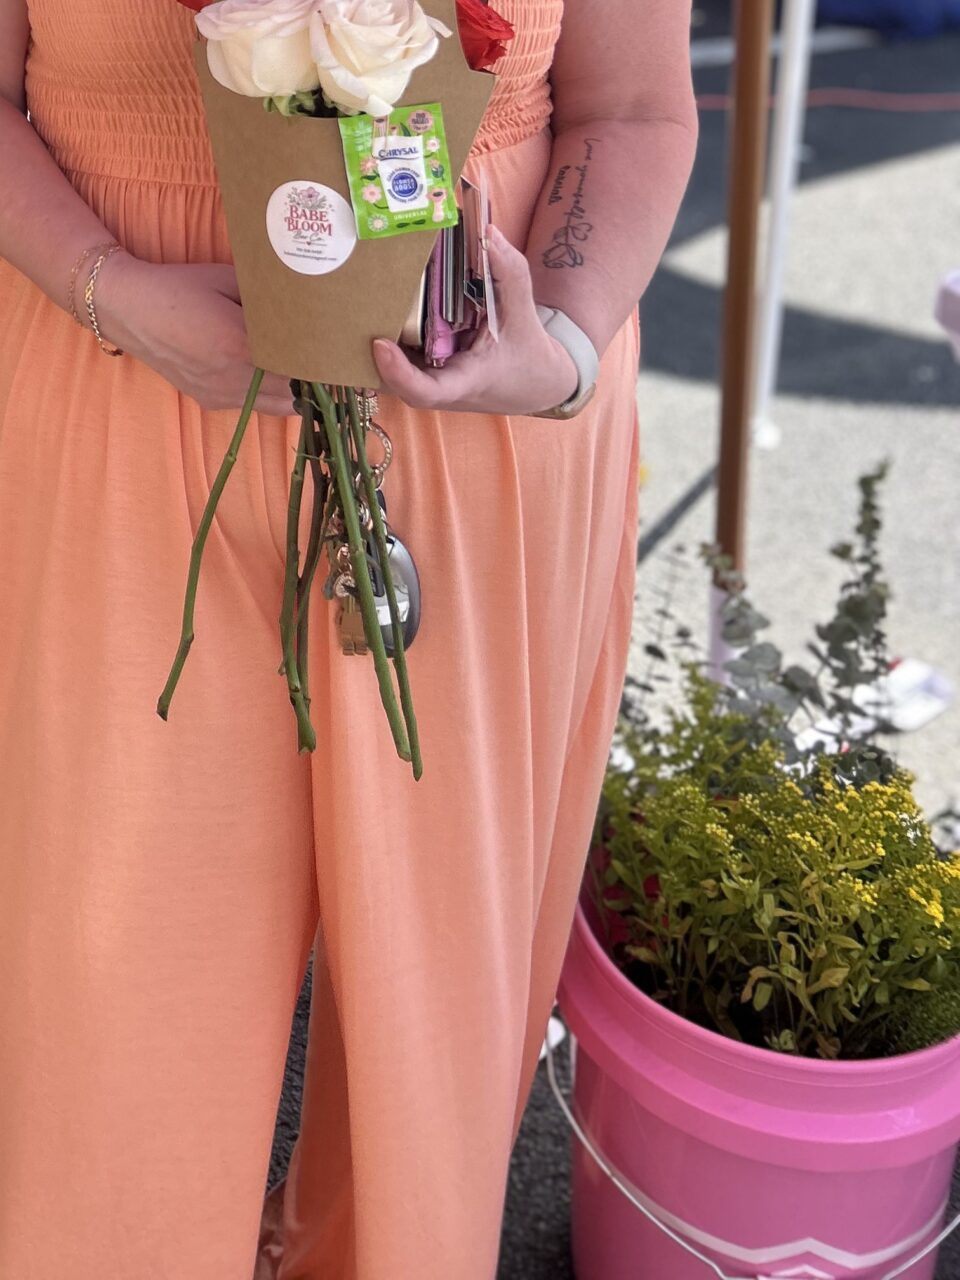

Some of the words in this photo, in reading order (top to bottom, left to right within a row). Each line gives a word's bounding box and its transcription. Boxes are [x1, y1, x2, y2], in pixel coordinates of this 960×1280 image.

[378, 146, 418, 158] CHRYSAL
[289, 204, 329, 222] BABE
[393, 210, 427, 220] UNIVERSAL
[284, 217, 332, 236] BLOOM
